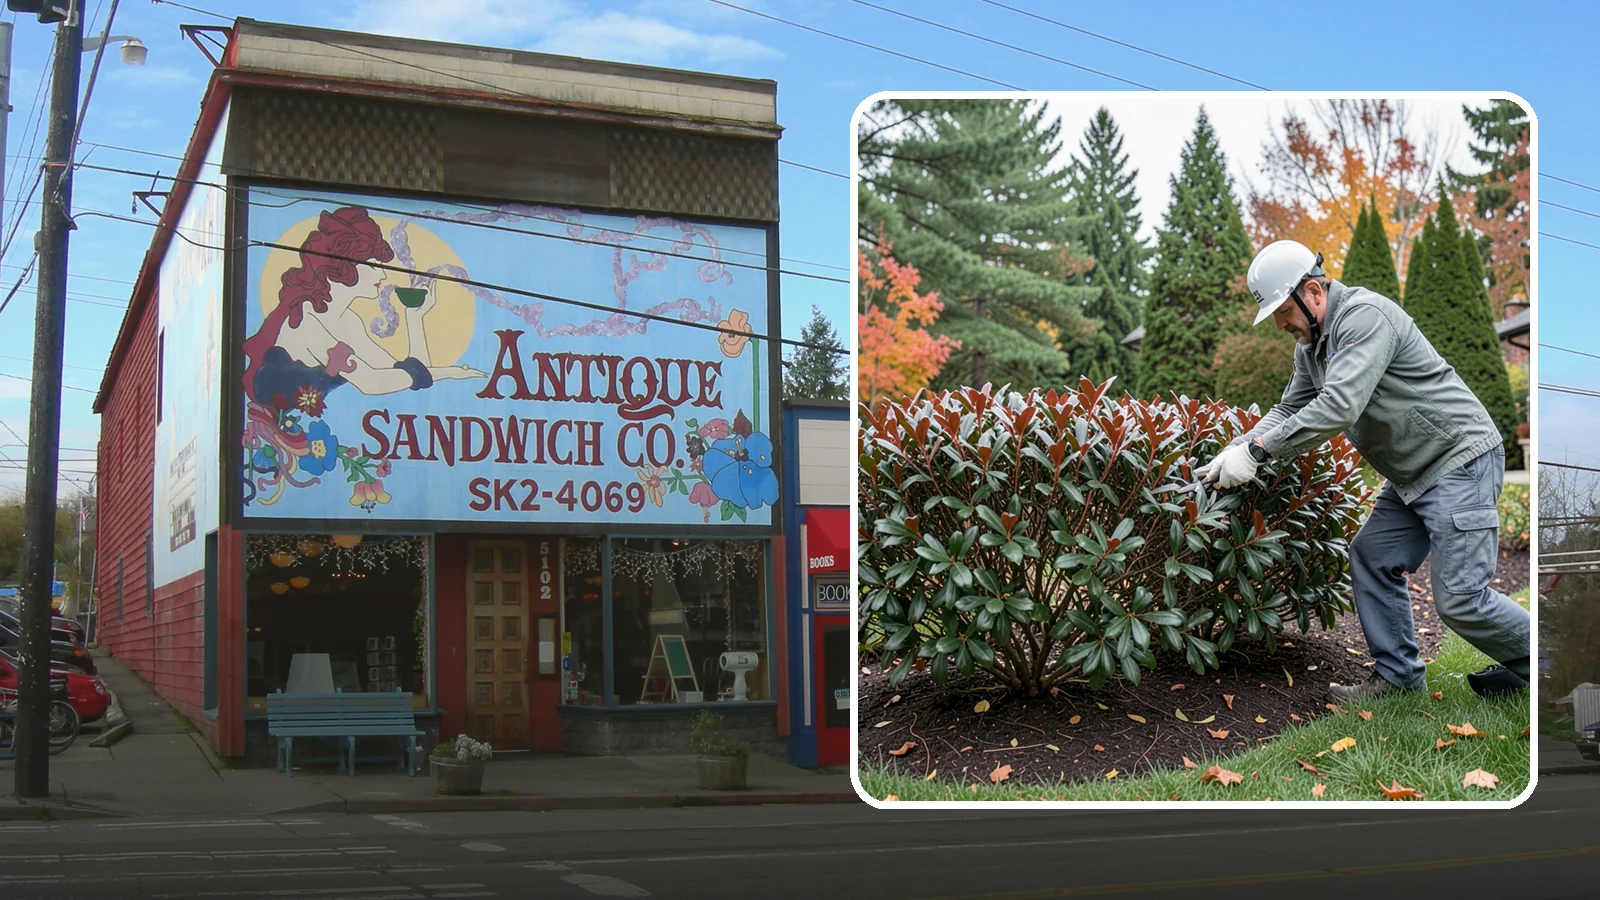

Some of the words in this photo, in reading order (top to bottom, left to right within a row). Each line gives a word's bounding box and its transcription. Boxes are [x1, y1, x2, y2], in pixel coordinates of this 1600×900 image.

[476, 328, 724, 421] ANTIQUE
[361, 408, 605, 467] SANDWICH
[616, 421, 686, 469] CO.
[468, 477, 647, 513] SK2-4069
[540, 541, 551, 599] 5102
[809, 555, 835, 569] BOOKS
